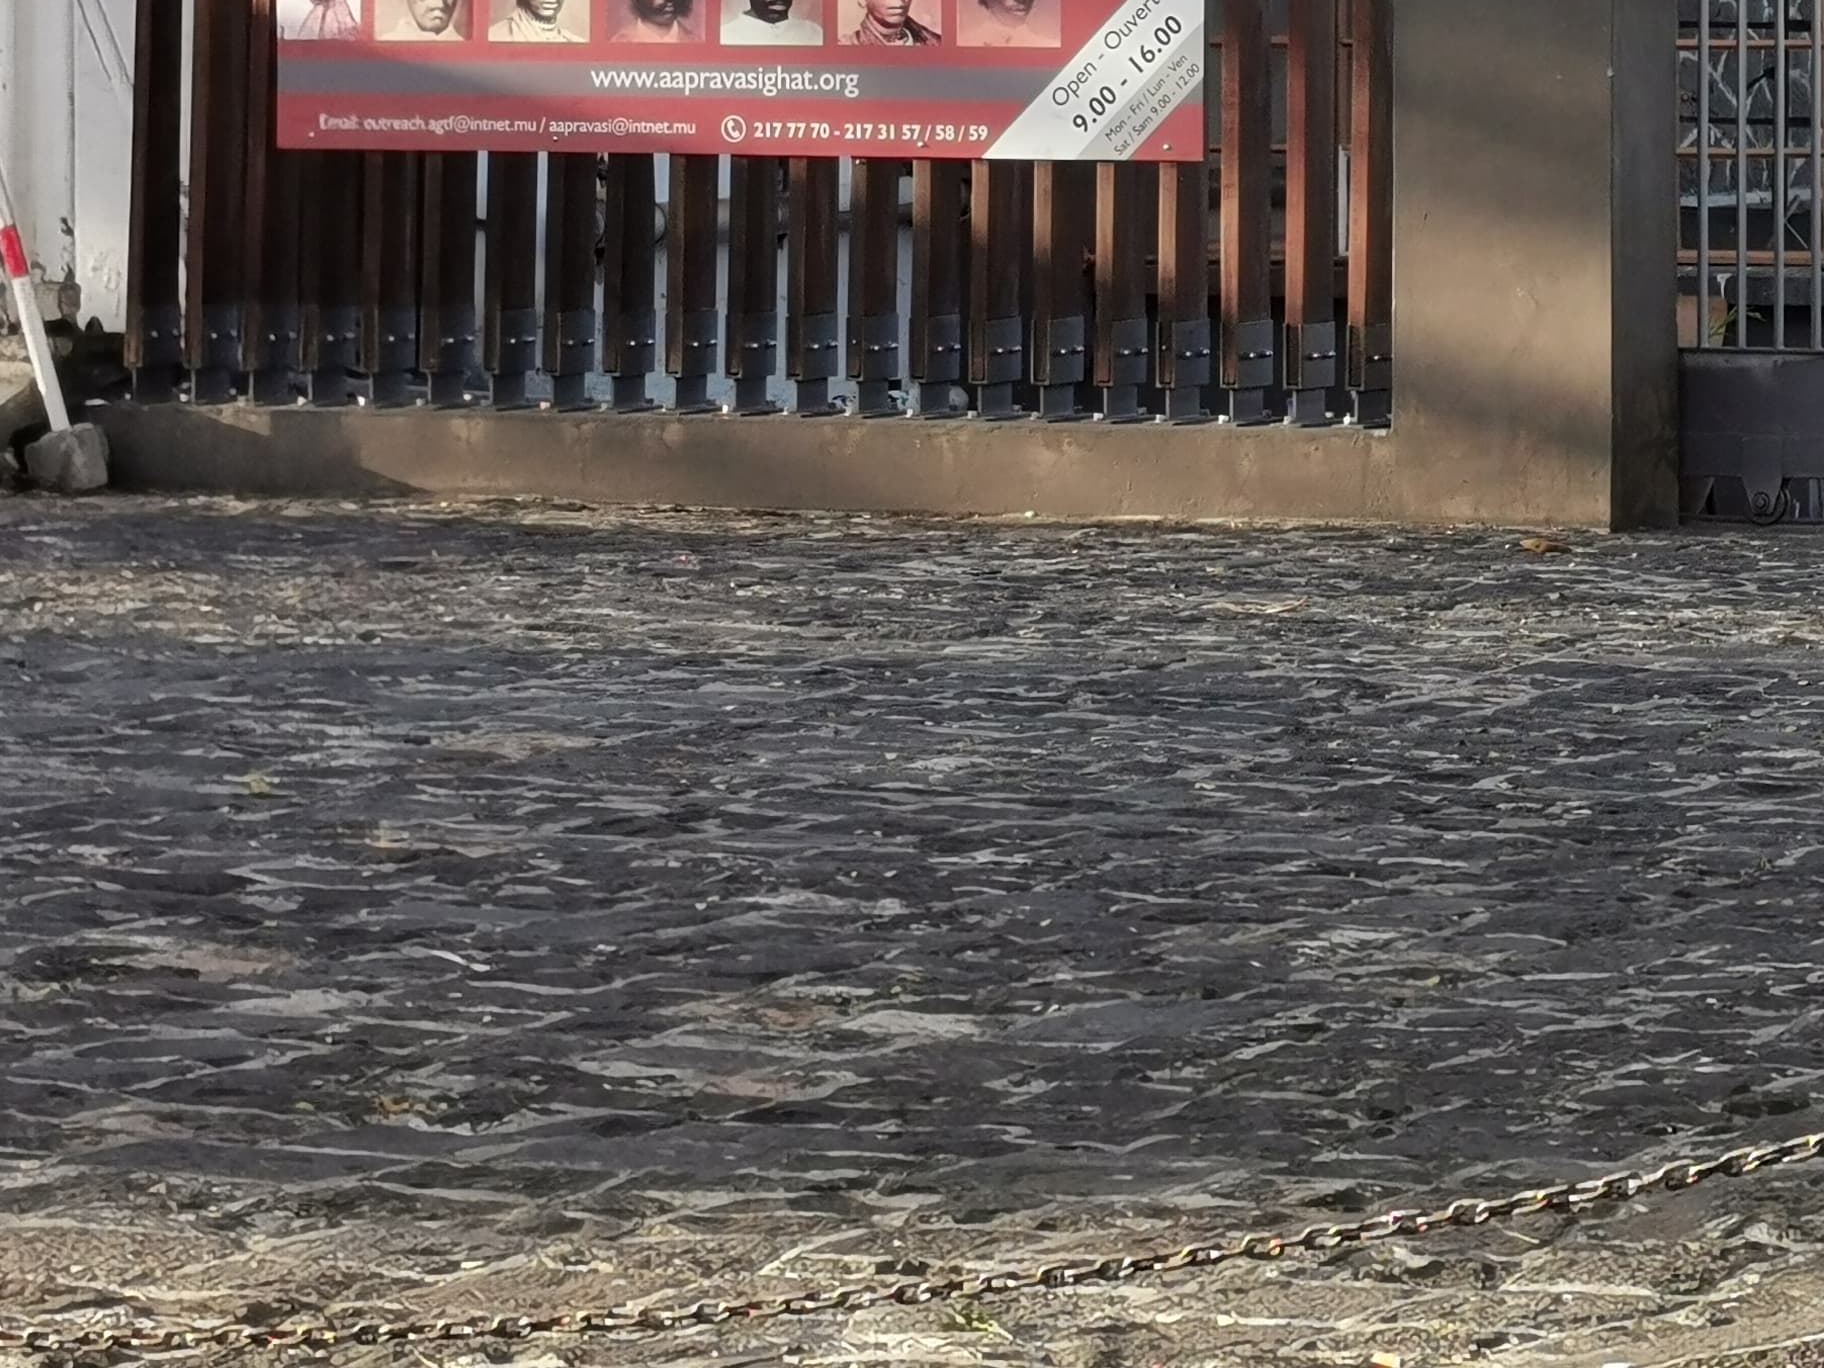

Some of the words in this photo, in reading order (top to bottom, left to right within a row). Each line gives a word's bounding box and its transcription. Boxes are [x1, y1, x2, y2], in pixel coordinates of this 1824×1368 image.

[590, 65, 859, 98] www.aapravasighat.org
[1052, 60, 1097, 106] Open
[1073, 86, 1117, 133] 9.00
[1128, 15, 1182, 73] 16.00
[1105, 119, 1127, 142] Mon
[1130, 99, 1145, 115] Fri
[1147, 78, 1166, 98] Lun
[1168, 55, 1188, 74] Ven
[1114, 139, 1131, 156] Sat
[1132, 114, 1154, 136] Sam
[1151, 95, 1172, 116] 9.00
[1175, 63, 1200, 91] 12.00
[549, 117, 696, 136] aapravasi@intnet.mu
[753, 122, 782, 139] 217
[786, 122, 805, 139] 77
[810, 123, 830, 139] 70
[844, 123, 872, 140] 217
[877, 124, 895, 140] 31
[901, 124, 921, 140] 57
[935, 125, 954, 140] 58
[968, 125, 988, 142] 59
